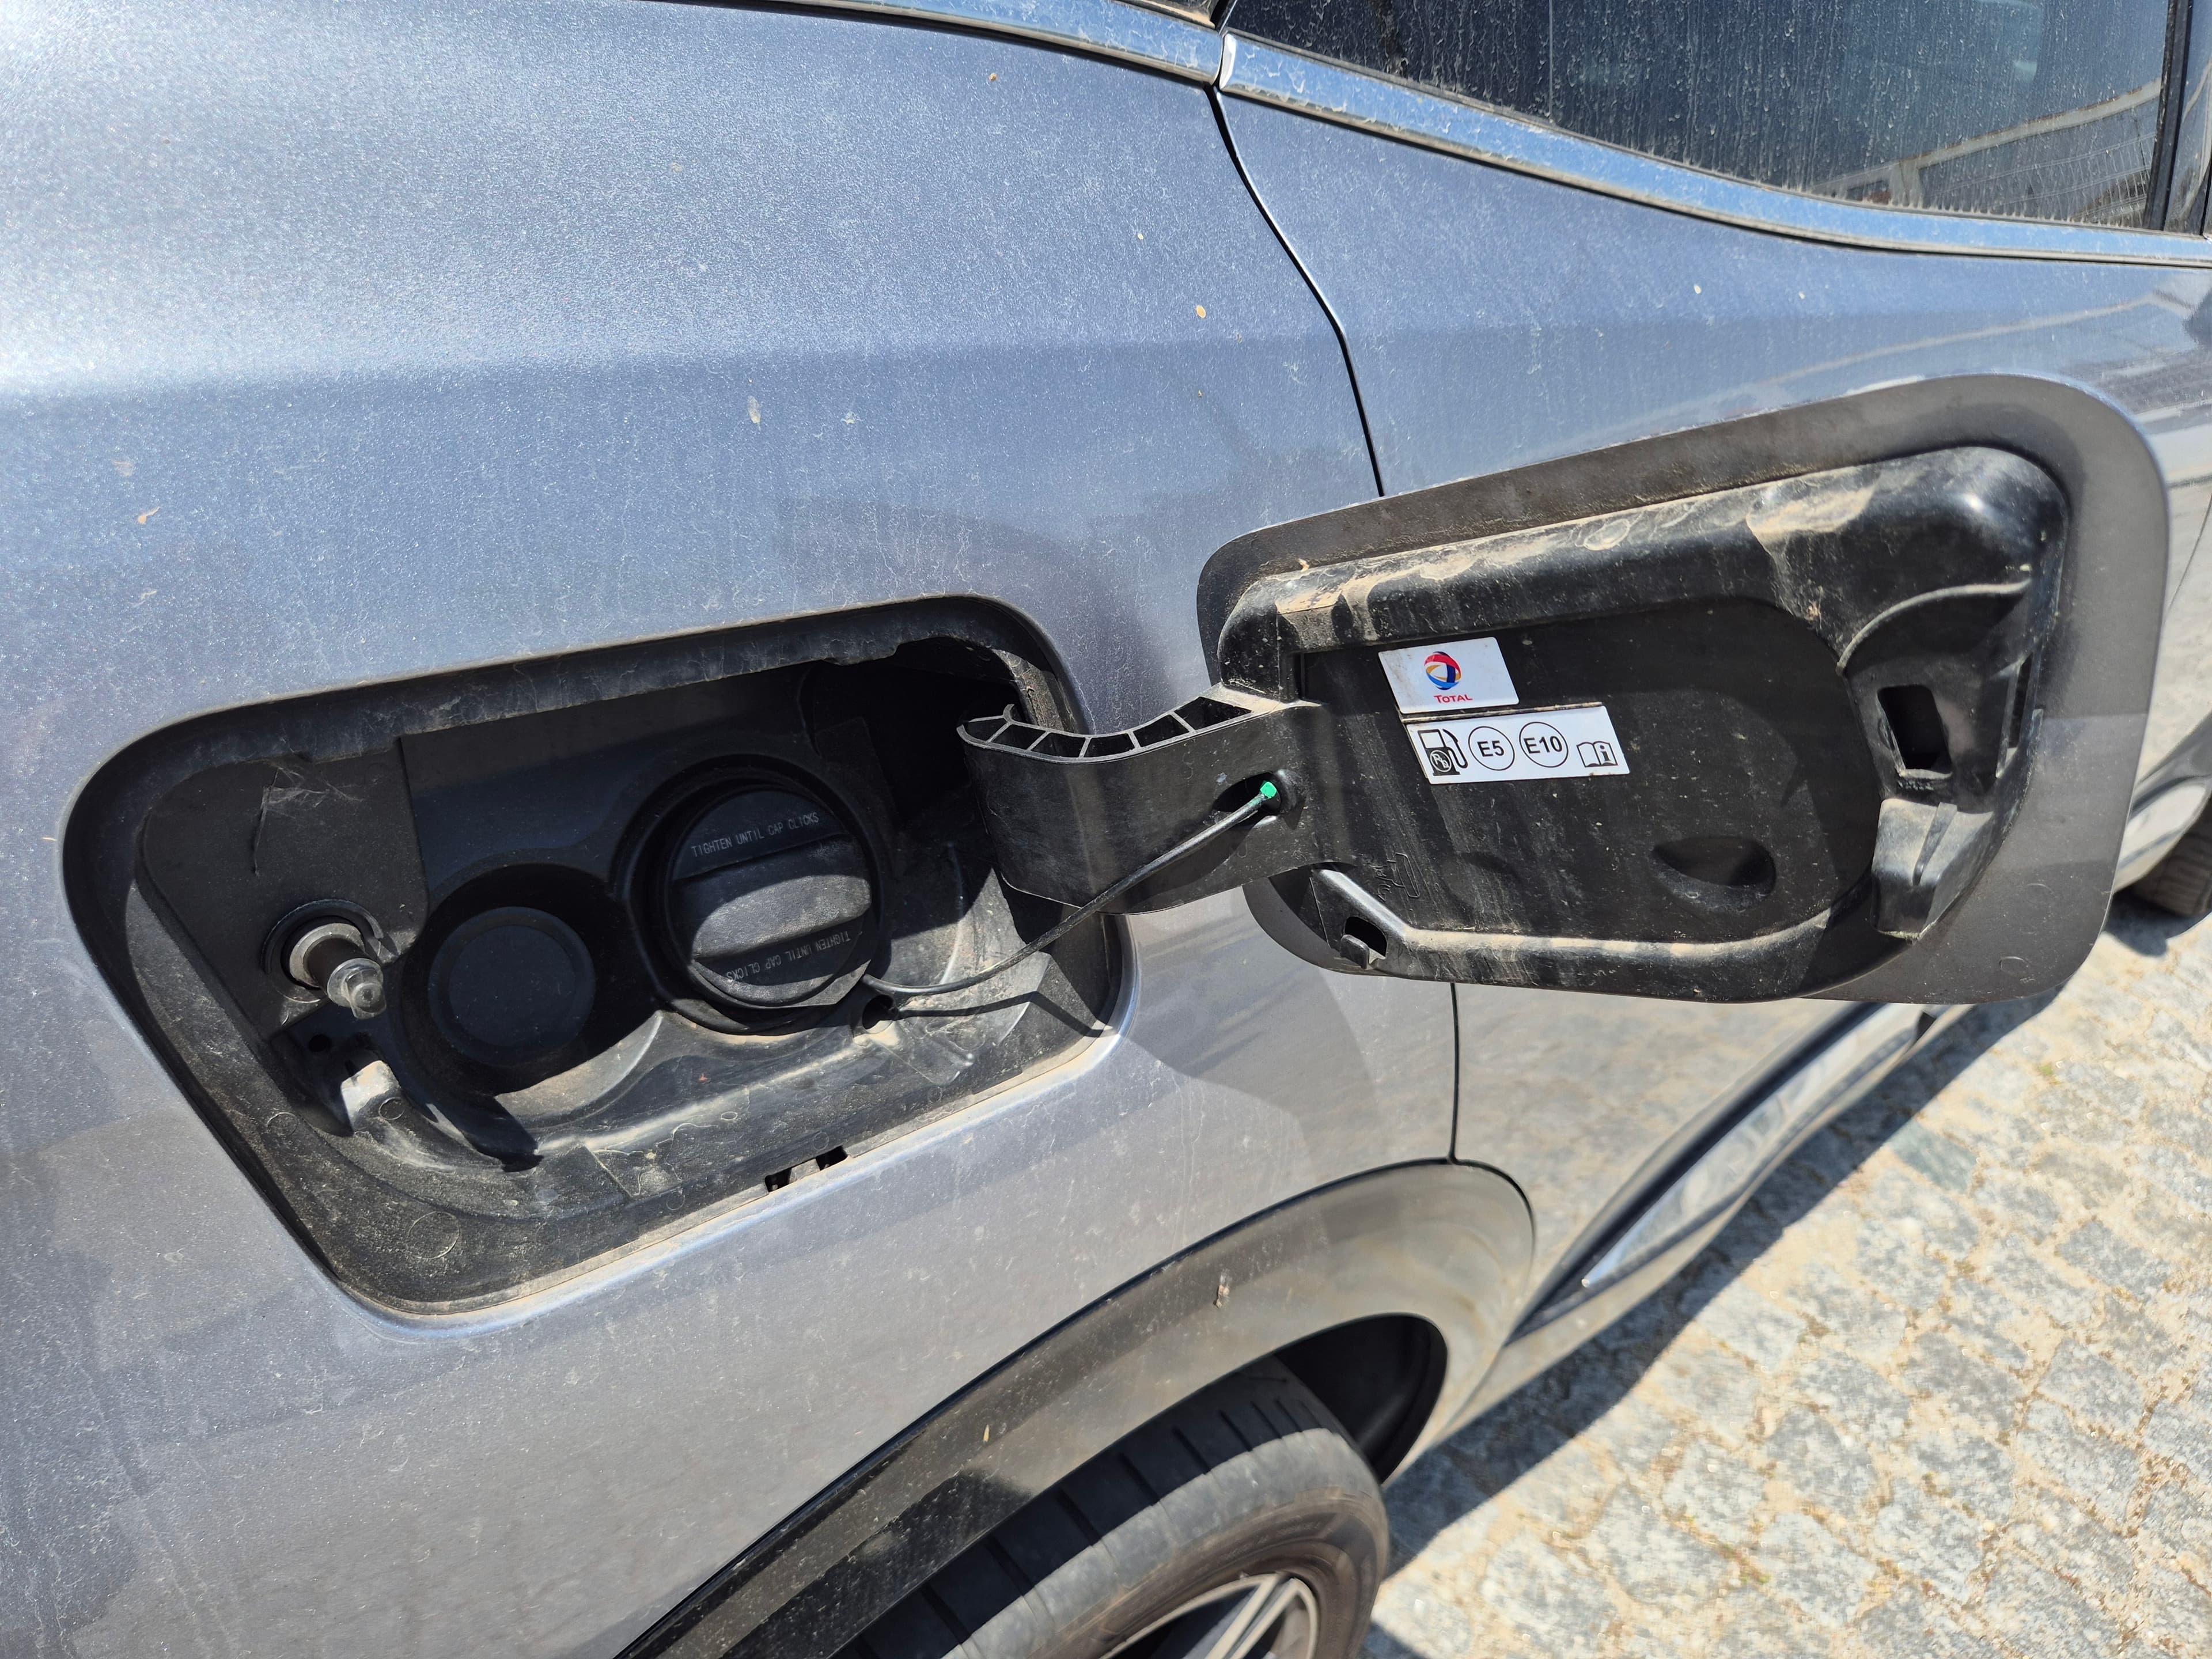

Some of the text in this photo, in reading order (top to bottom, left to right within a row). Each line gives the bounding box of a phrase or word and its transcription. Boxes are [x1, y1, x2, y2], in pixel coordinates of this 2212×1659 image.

[1434, 693, 1473, 704] TOTAL
[1477, 740, 1505, 757] E5
[1524, 736, 1563, 755] E10
[691, 812, 820, 857] TIGHTEN UNTIL CAP CLICKS
[726, 930, 851, 980] TIGHTEN UNTIL CAP CLICKS
